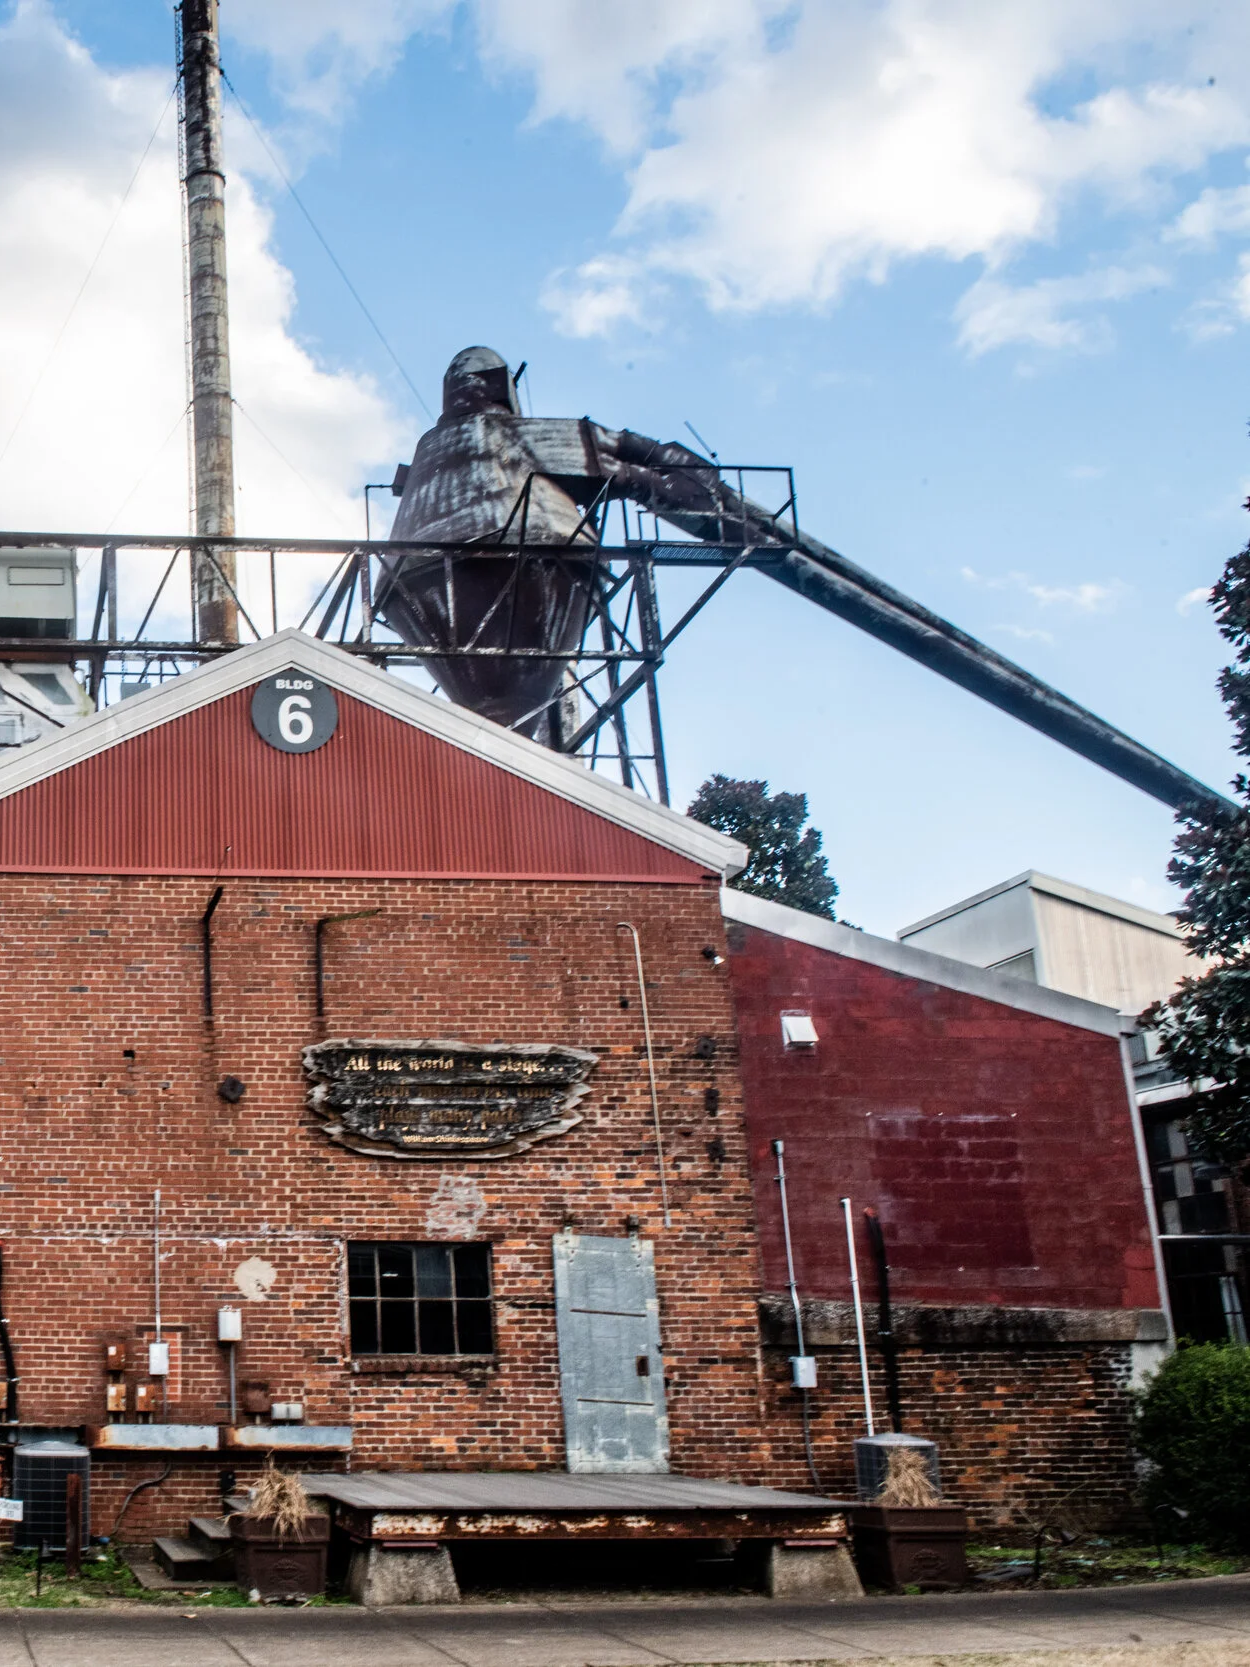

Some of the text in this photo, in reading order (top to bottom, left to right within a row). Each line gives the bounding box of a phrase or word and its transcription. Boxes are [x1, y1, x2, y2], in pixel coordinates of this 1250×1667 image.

[275, 679, 314, 690] BLDG
[278, 694, 314, 744] 6
[344, 1055, 371, 1071] All
[377, 1056, 403, 1072] the
[409, 1055, 454, 1072] world
[482, 1059, 493, 1071] a
[429, 1108, 473, 1131] many
